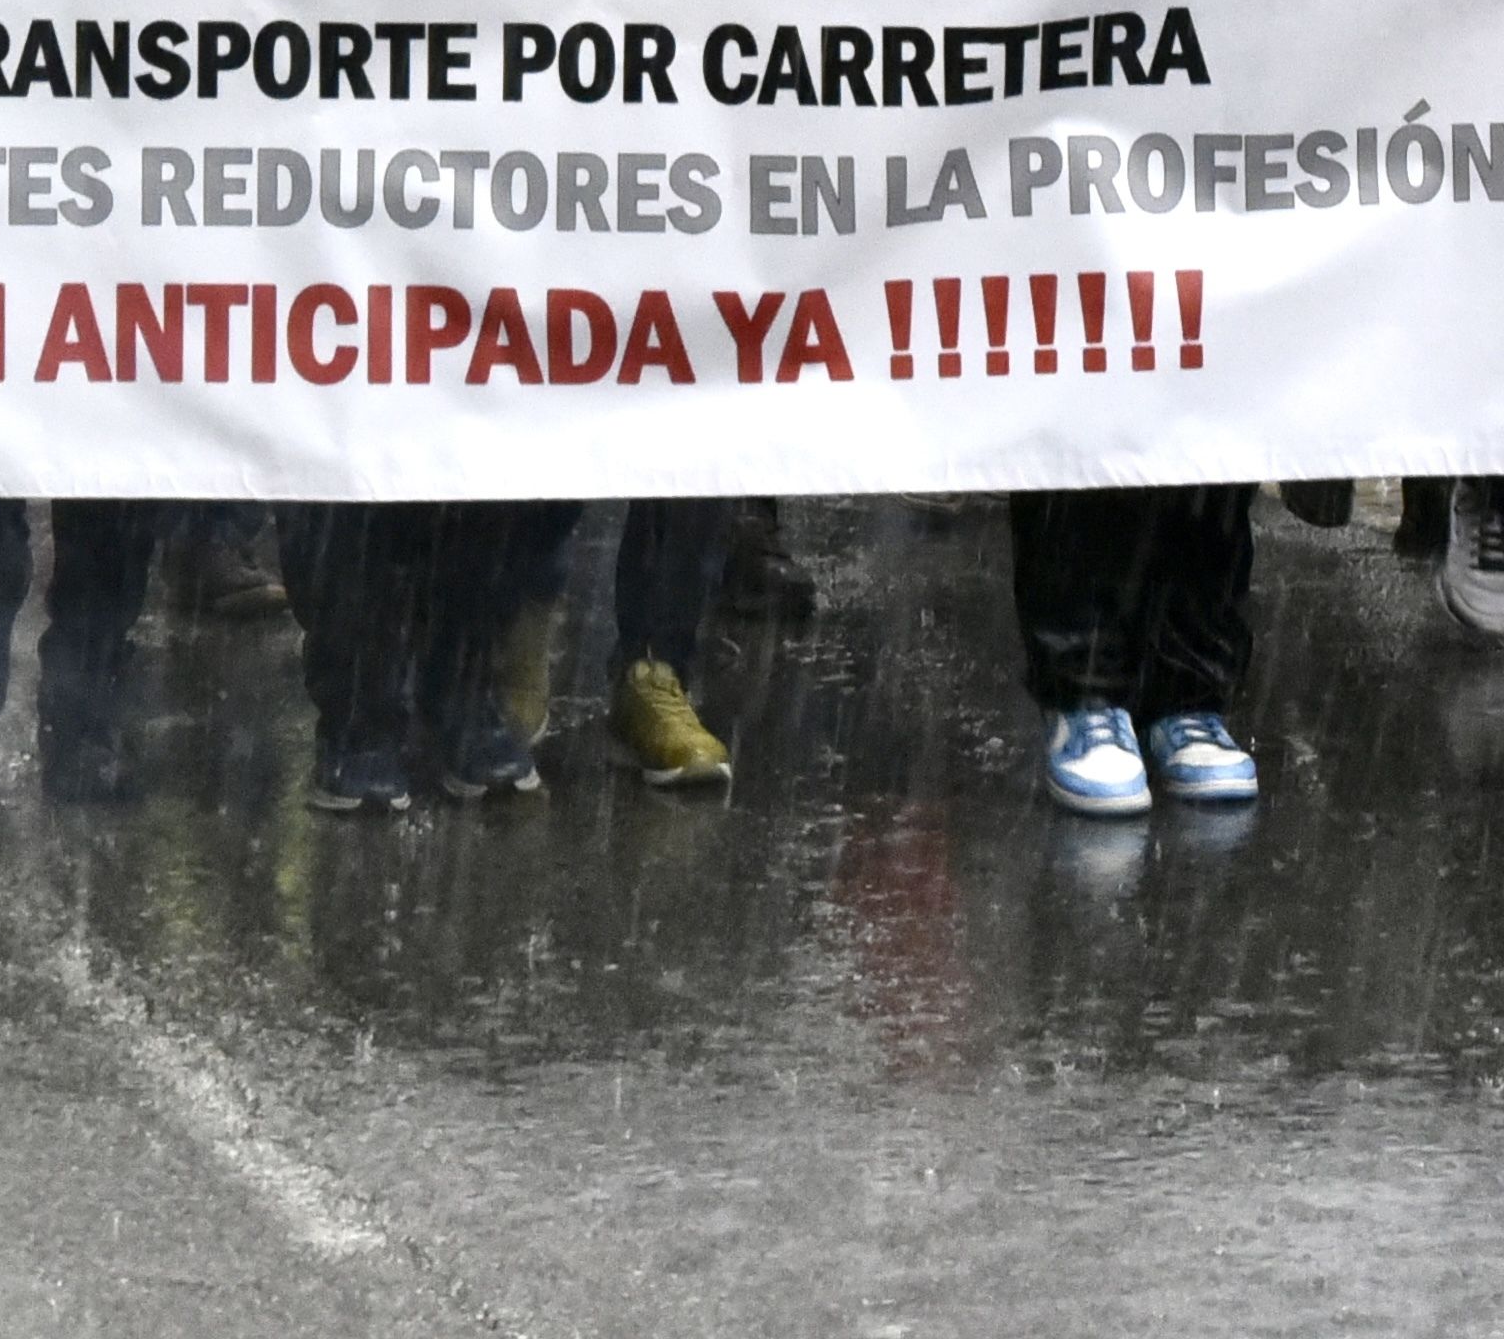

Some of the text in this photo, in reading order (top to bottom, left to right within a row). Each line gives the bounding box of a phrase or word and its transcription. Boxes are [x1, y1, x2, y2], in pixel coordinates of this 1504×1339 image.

[503, 21, 678, 105] POR
[703, 7, 1211, 107] CARRETERA
[141, 146, 722, 235] REDUCTORES
[749, 154, 856, 237] EN
[885, 147, 987, 228] LA
[34, 281, 694, 387] ANTICIPADA
[710, 289, 854, 386] YA
